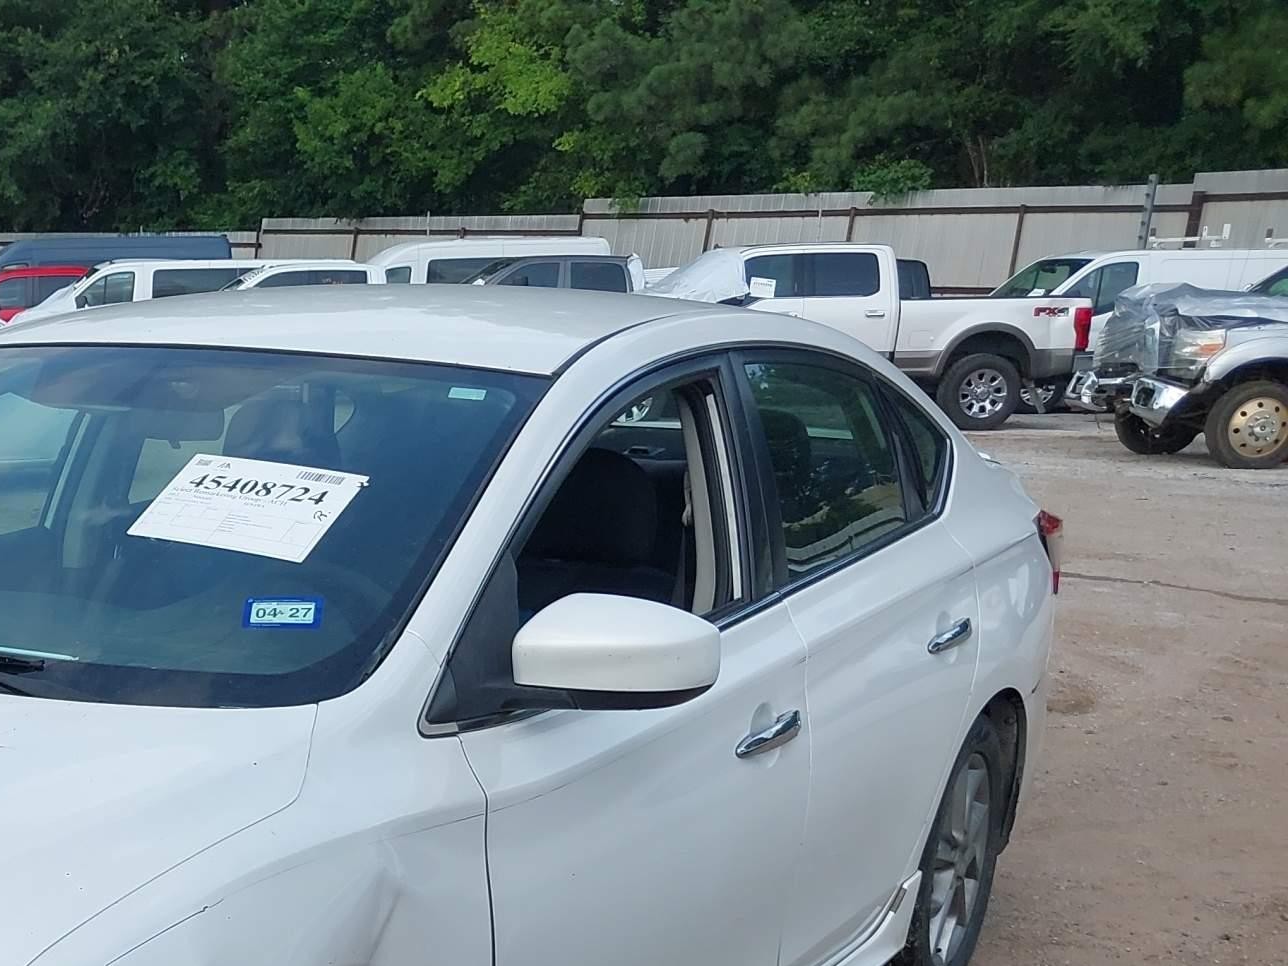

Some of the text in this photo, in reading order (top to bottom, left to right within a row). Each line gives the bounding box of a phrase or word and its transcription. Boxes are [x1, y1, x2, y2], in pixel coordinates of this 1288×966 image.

[1033, 307, 1069, 317] FX4
[189, 472, 330, 506] 45408724
[255, 607, 313, 619] 04 27
